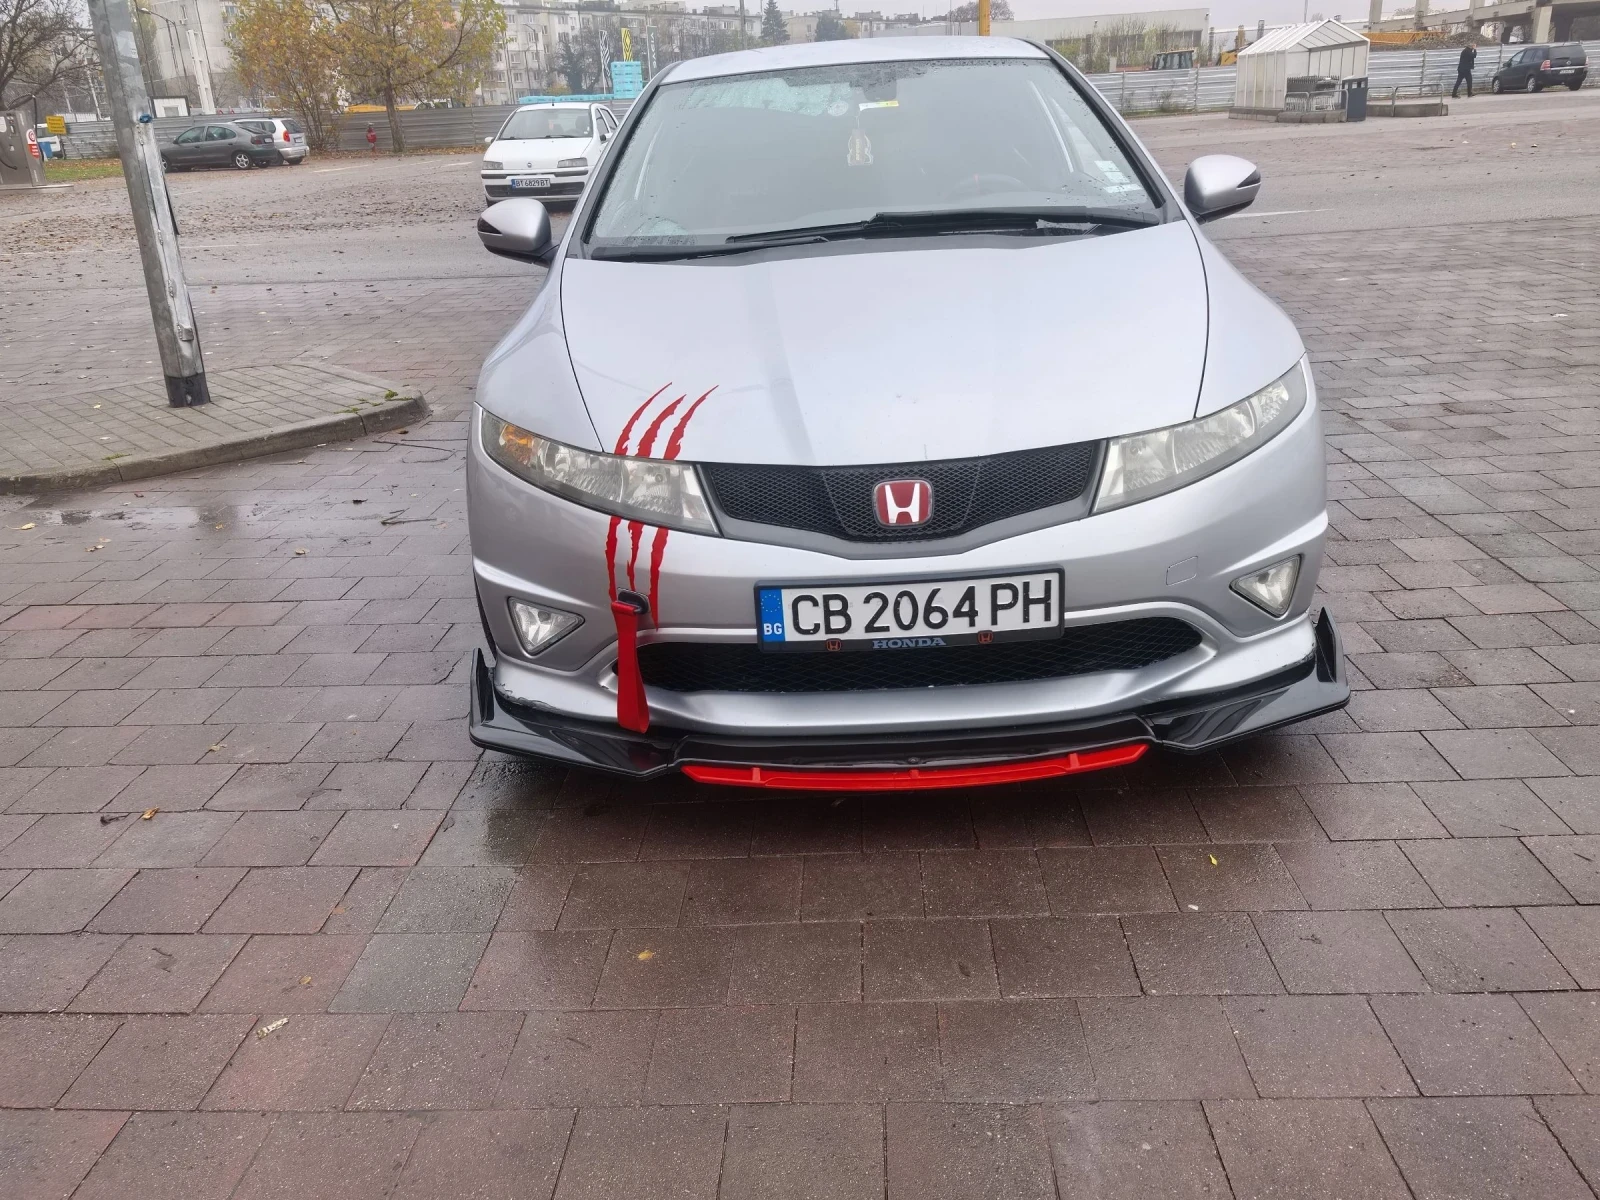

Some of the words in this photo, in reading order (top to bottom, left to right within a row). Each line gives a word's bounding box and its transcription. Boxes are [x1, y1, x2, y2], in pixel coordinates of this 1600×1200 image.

[791, 593, 852, 635] CB
[863, 585, 978, 633] 2064
[990, 579, 1052, 626] PH
[763, 622, 783, 636] BG
[872, 637, 947, 649] HONDA
